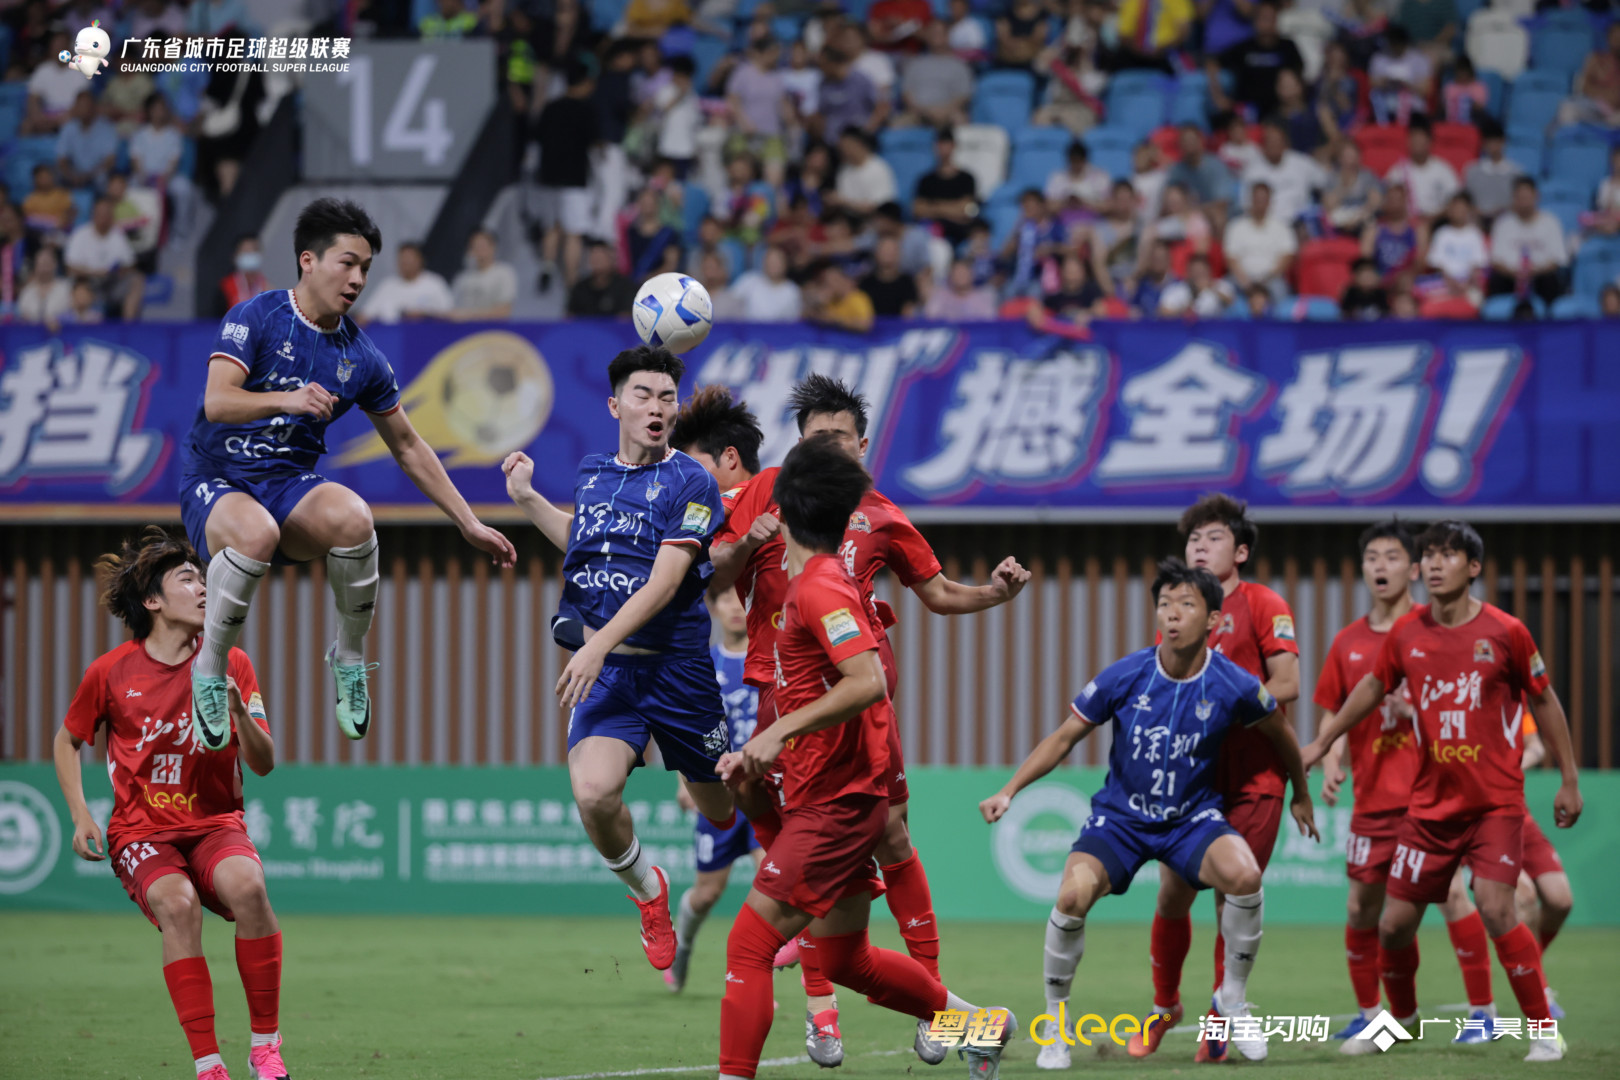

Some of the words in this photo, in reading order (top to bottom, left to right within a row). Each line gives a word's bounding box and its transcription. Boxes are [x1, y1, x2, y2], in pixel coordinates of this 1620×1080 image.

[336, 53, 454, 167] 14
[576, 502, 645, 545] 深圳
[572, 563, 640, 595] cleer
[1439, 709, 1467, 739] 34
[1132, 725, 1201, 767] 深圳
[150, 753, 185, 785] 23
[1150, 768, 1177, 796] 21
[1390, 843, 1426, 884] 34
